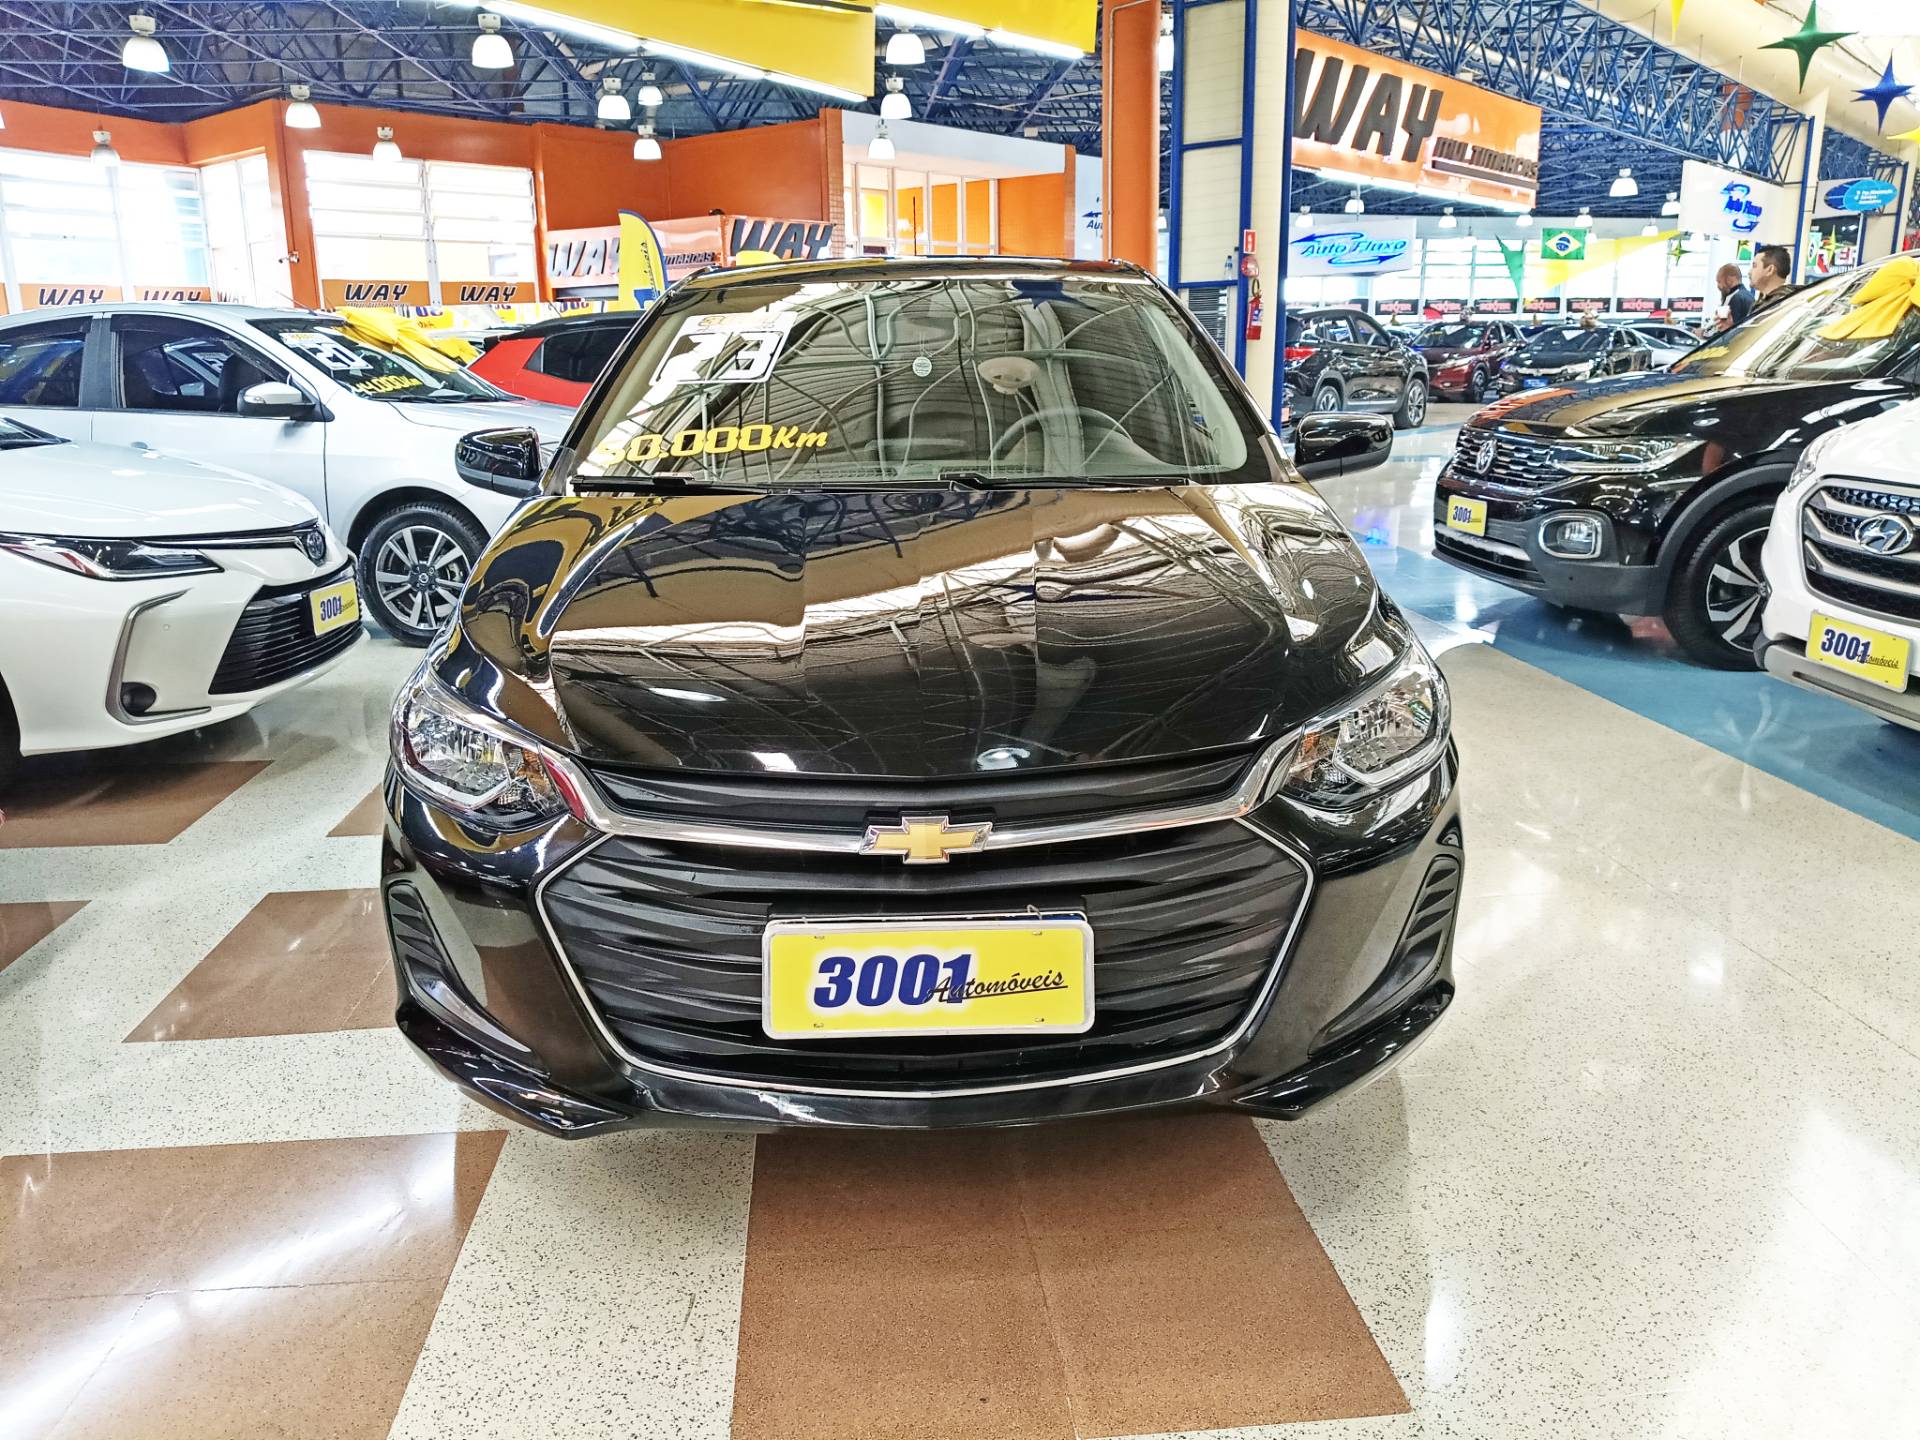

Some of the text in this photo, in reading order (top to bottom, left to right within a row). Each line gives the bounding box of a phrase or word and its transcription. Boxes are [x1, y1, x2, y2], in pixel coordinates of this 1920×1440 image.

[1293, 47, 1444, 163] WAY
[1432, 136, 1539, 179] MULTIMARCAS
[731, 218, 835, 260] WAY
[1300, 240, 1407, 256] Auto Fluxo
[39, 288, 104, 305] WAY
[345, 283, 408, 301] WAY
[460, 286, 516, 301] WAY
[1453, 505, 1472, 524] 3001
[320, 595, 342, 621] 3001
[1821, 628, 1871, 664] 3001
[813, 953, 1069, 1008] 3001 Automóveis
